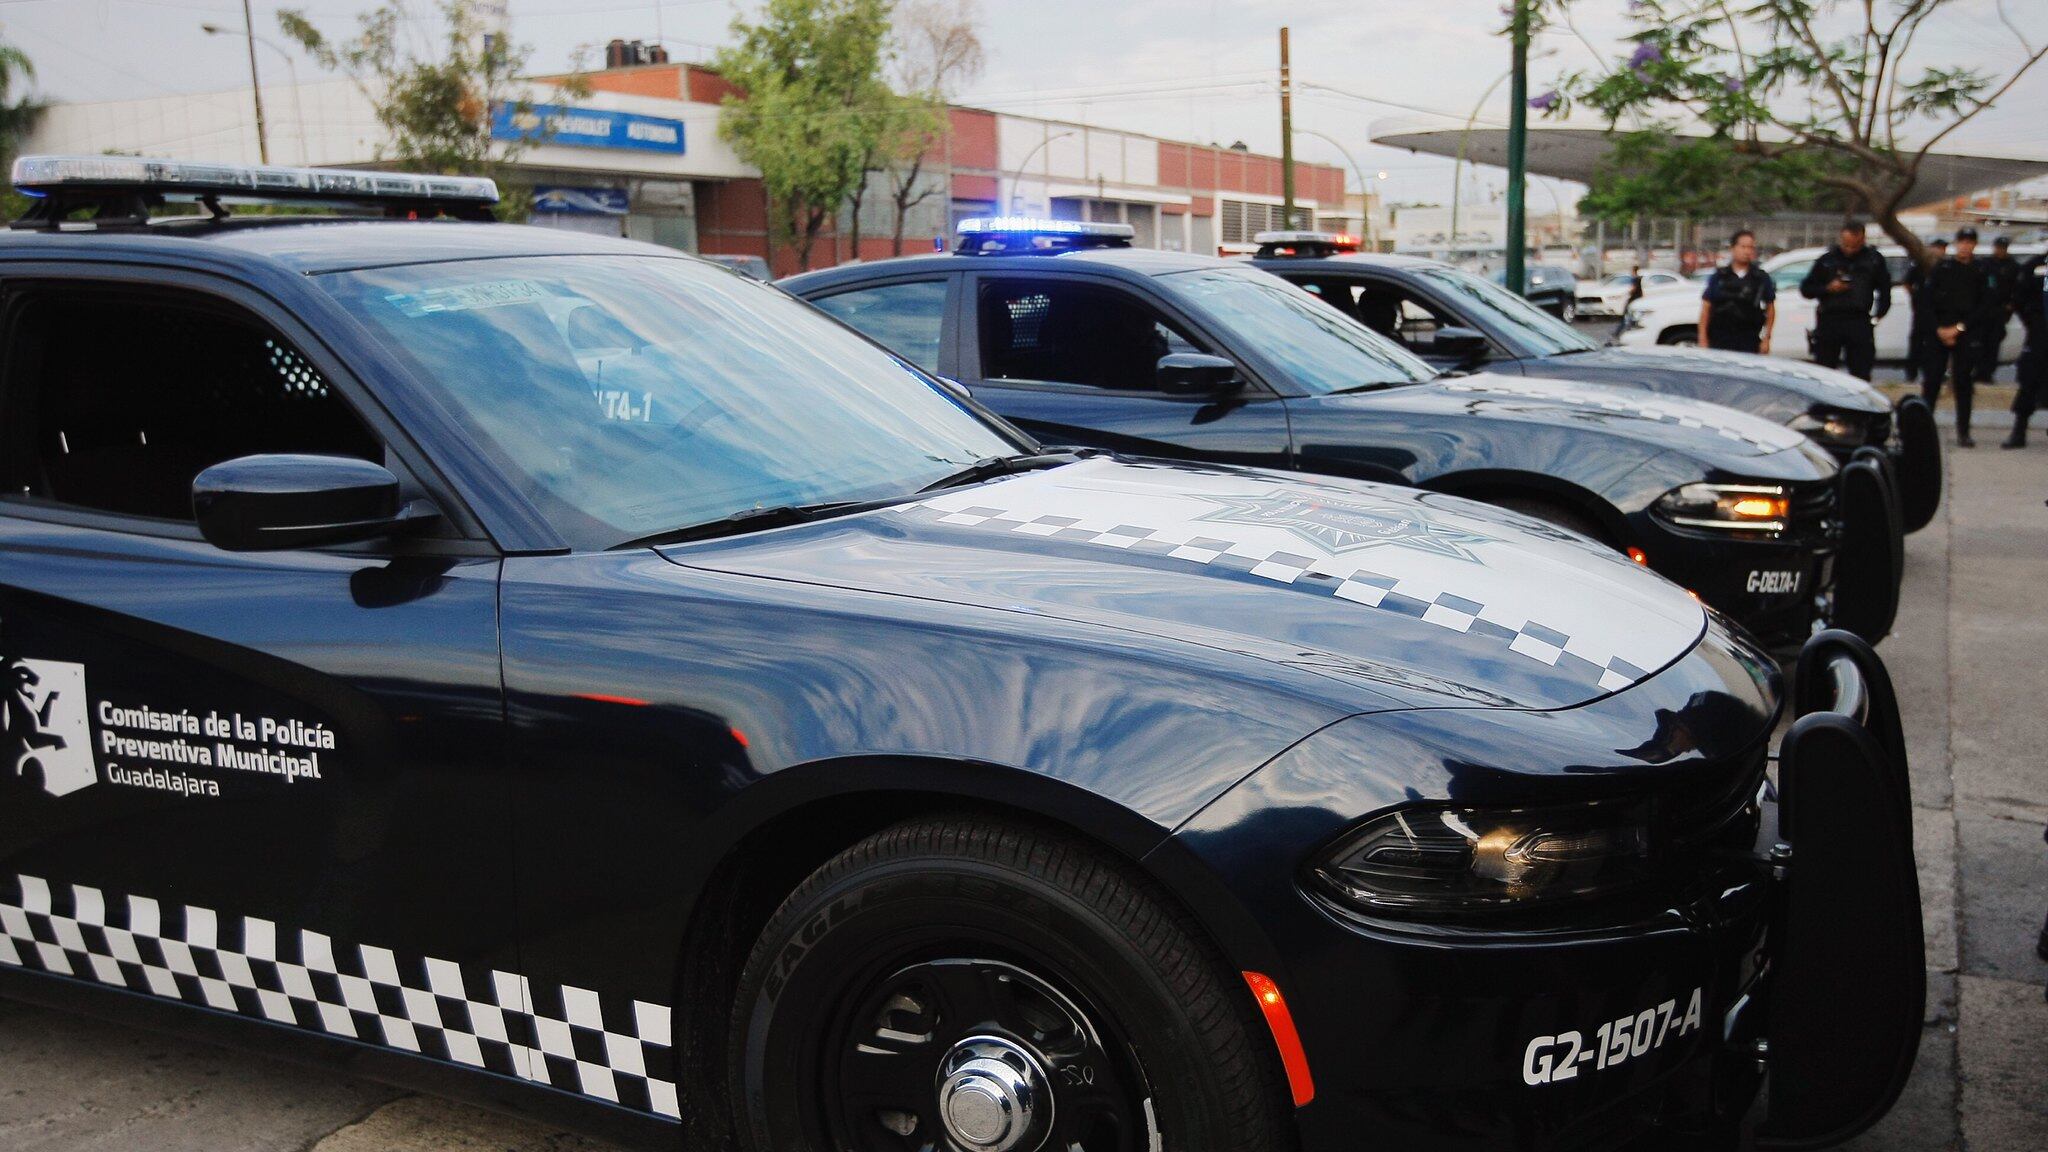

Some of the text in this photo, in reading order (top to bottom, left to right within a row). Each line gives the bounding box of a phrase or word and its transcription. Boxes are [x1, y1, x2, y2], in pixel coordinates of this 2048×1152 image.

[593, 389, 653, 423] TA-1
[1746, 570, 1801, 593] G-DELTA-1
[99, 700, 336, 750] Comisaría de la Policía
[102, 729, 322, 784] Preventiva Municipal
[107, 762, 221, 798] Guadalajara
[1522, 986, 1702, 1086] G2-1507-A
